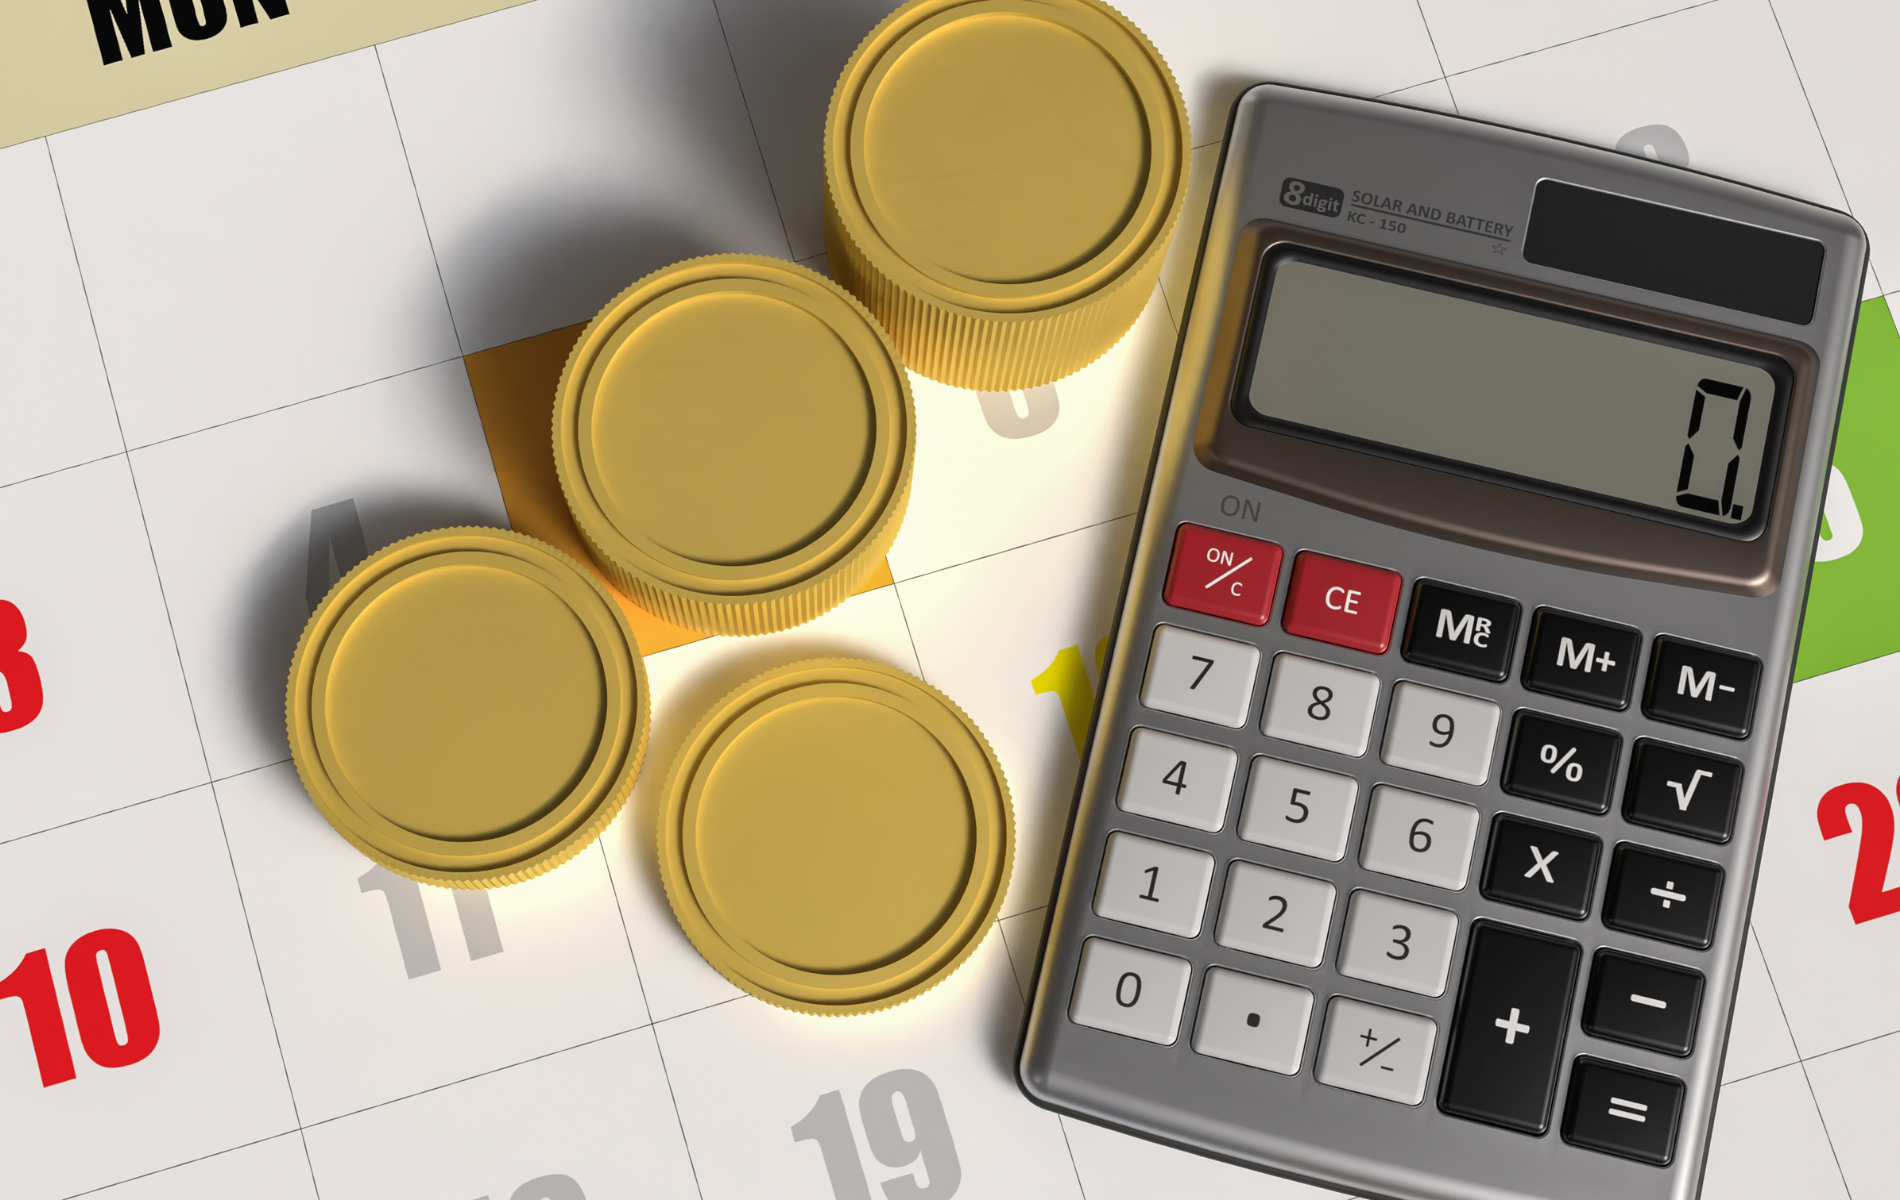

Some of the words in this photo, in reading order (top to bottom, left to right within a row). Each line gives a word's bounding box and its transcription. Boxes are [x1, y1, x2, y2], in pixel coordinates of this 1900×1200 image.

[1347, 211, 1367, 225] KC
[1379, 218, 1407, 234] 150
[1351, 190, 1403, 213] SOLAR
[1406, 203, 1442, 221] AND
[1446, 211, 1514, 238] BATTERY
[1221, 495, 1261, 522] ON
[1325, 586, 1362, 615] CE
[1190, 656, 1214, 690] 7
[1556, 636, 1616, 673] M+
[1031, 633, 1110, 763] 1
[1677, 665, 1736, 702] M-
[1308, 686, 1333, 721] 8
[1430, 714, 1455, 749] 9
[1162, 760, 1187, 796] 4
[1286, 788, 1311, 824] 5
[1409, 818, 1435, 853] 6
[1817, 775, 1900, 925] 2
[1139, 866, 1160, 903] 1
[1262, 896, 1288, 933] 2
[1386, 924, 1412, 961] 3
[0, 928, 160, 1088] 10
[1115, 971, 1142, 1008] 0
[790, 1069, 962, 1200] 19
